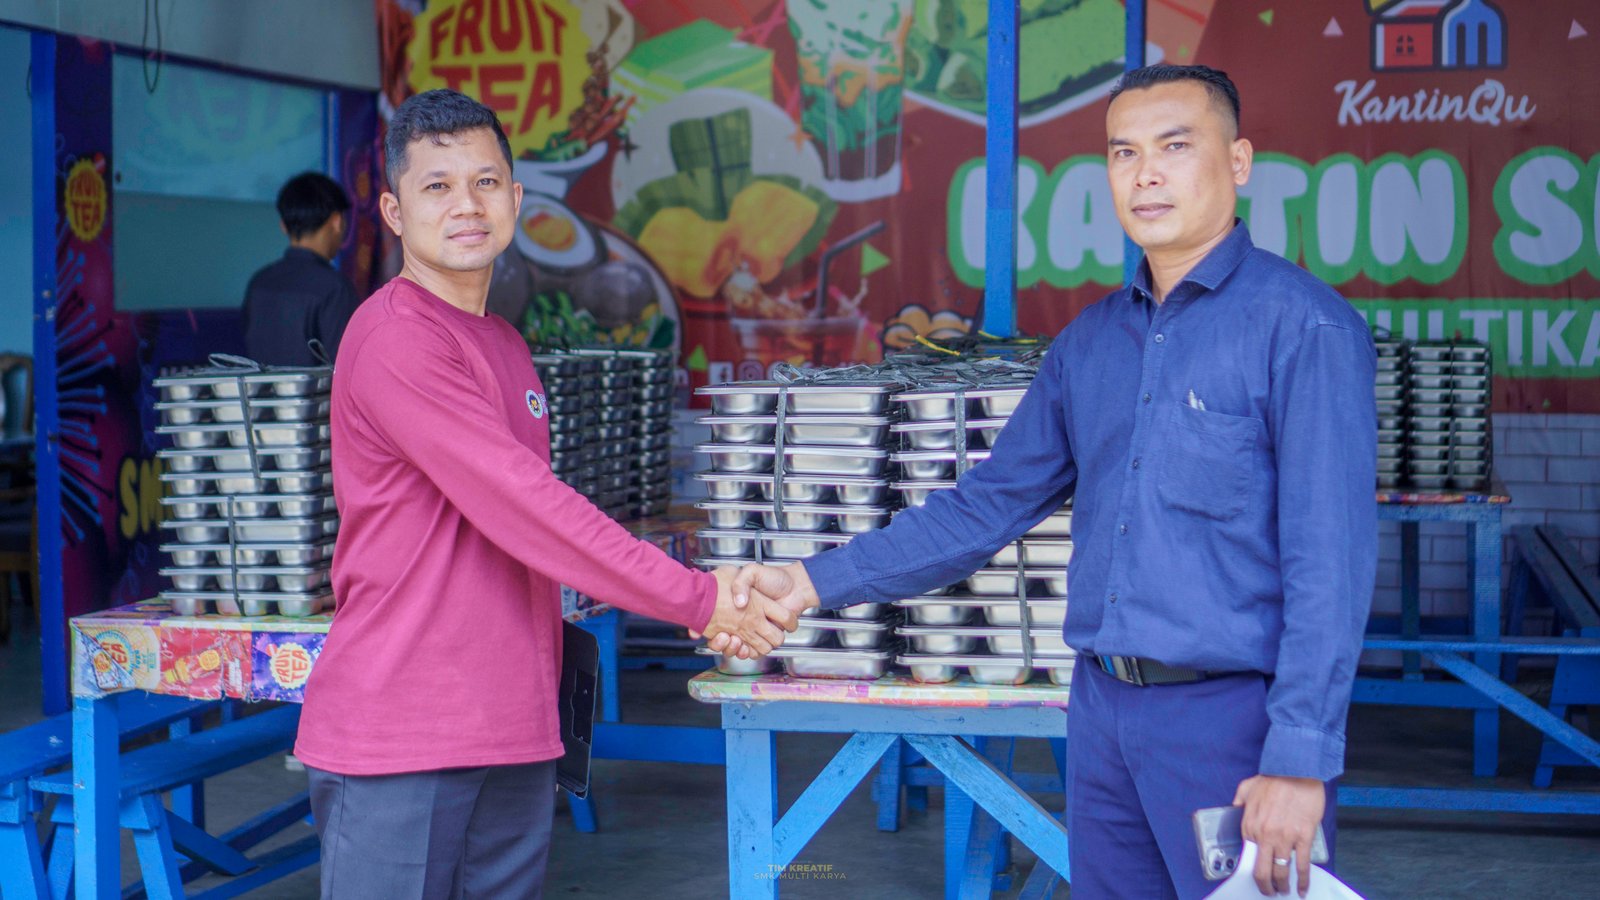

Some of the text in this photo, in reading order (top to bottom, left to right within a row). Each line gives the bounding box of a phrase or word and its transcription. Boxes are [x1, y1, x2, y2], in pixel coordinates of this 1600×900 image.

[430, 0, 567, 60] FRUIT
[431, 62, 562, 136] TEA
[1333, 78, 1537, 127] KantinQu
[72, 200, 101, 232] TEA
[957, 154, 1600, 271] KATIN S
[120, 458, 173, 538] SM
[275, 648, 291, 684] FRUIT
[291, 648, 308, 683] TEA
